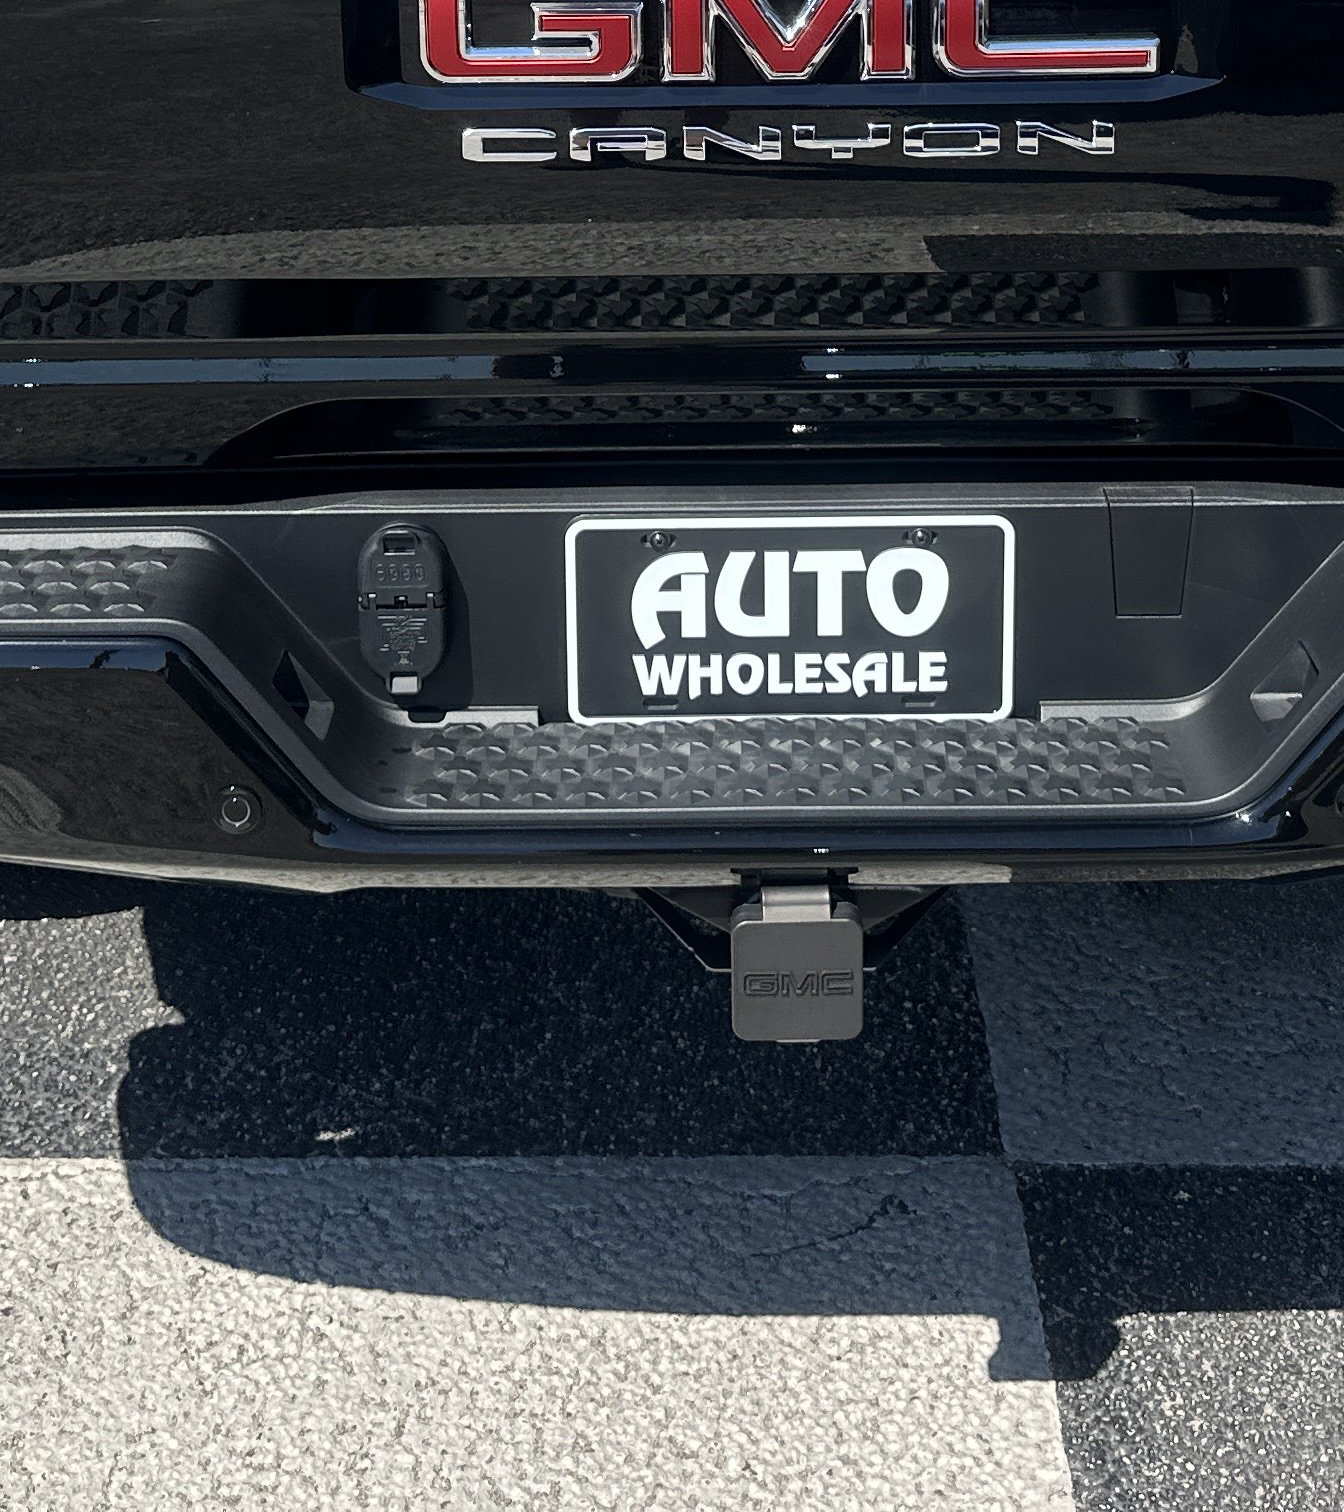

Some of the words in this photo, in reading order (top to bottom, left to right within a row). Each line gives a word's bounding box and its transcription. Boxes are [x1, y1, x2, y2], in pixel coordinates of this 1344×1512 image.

[461, 120, 1118, 163] CANYON
[631, 547, 951, 650] AUTO
[632, 651, 949, 698] WHOLESALE
[743, 969, 854, 998] GMC
